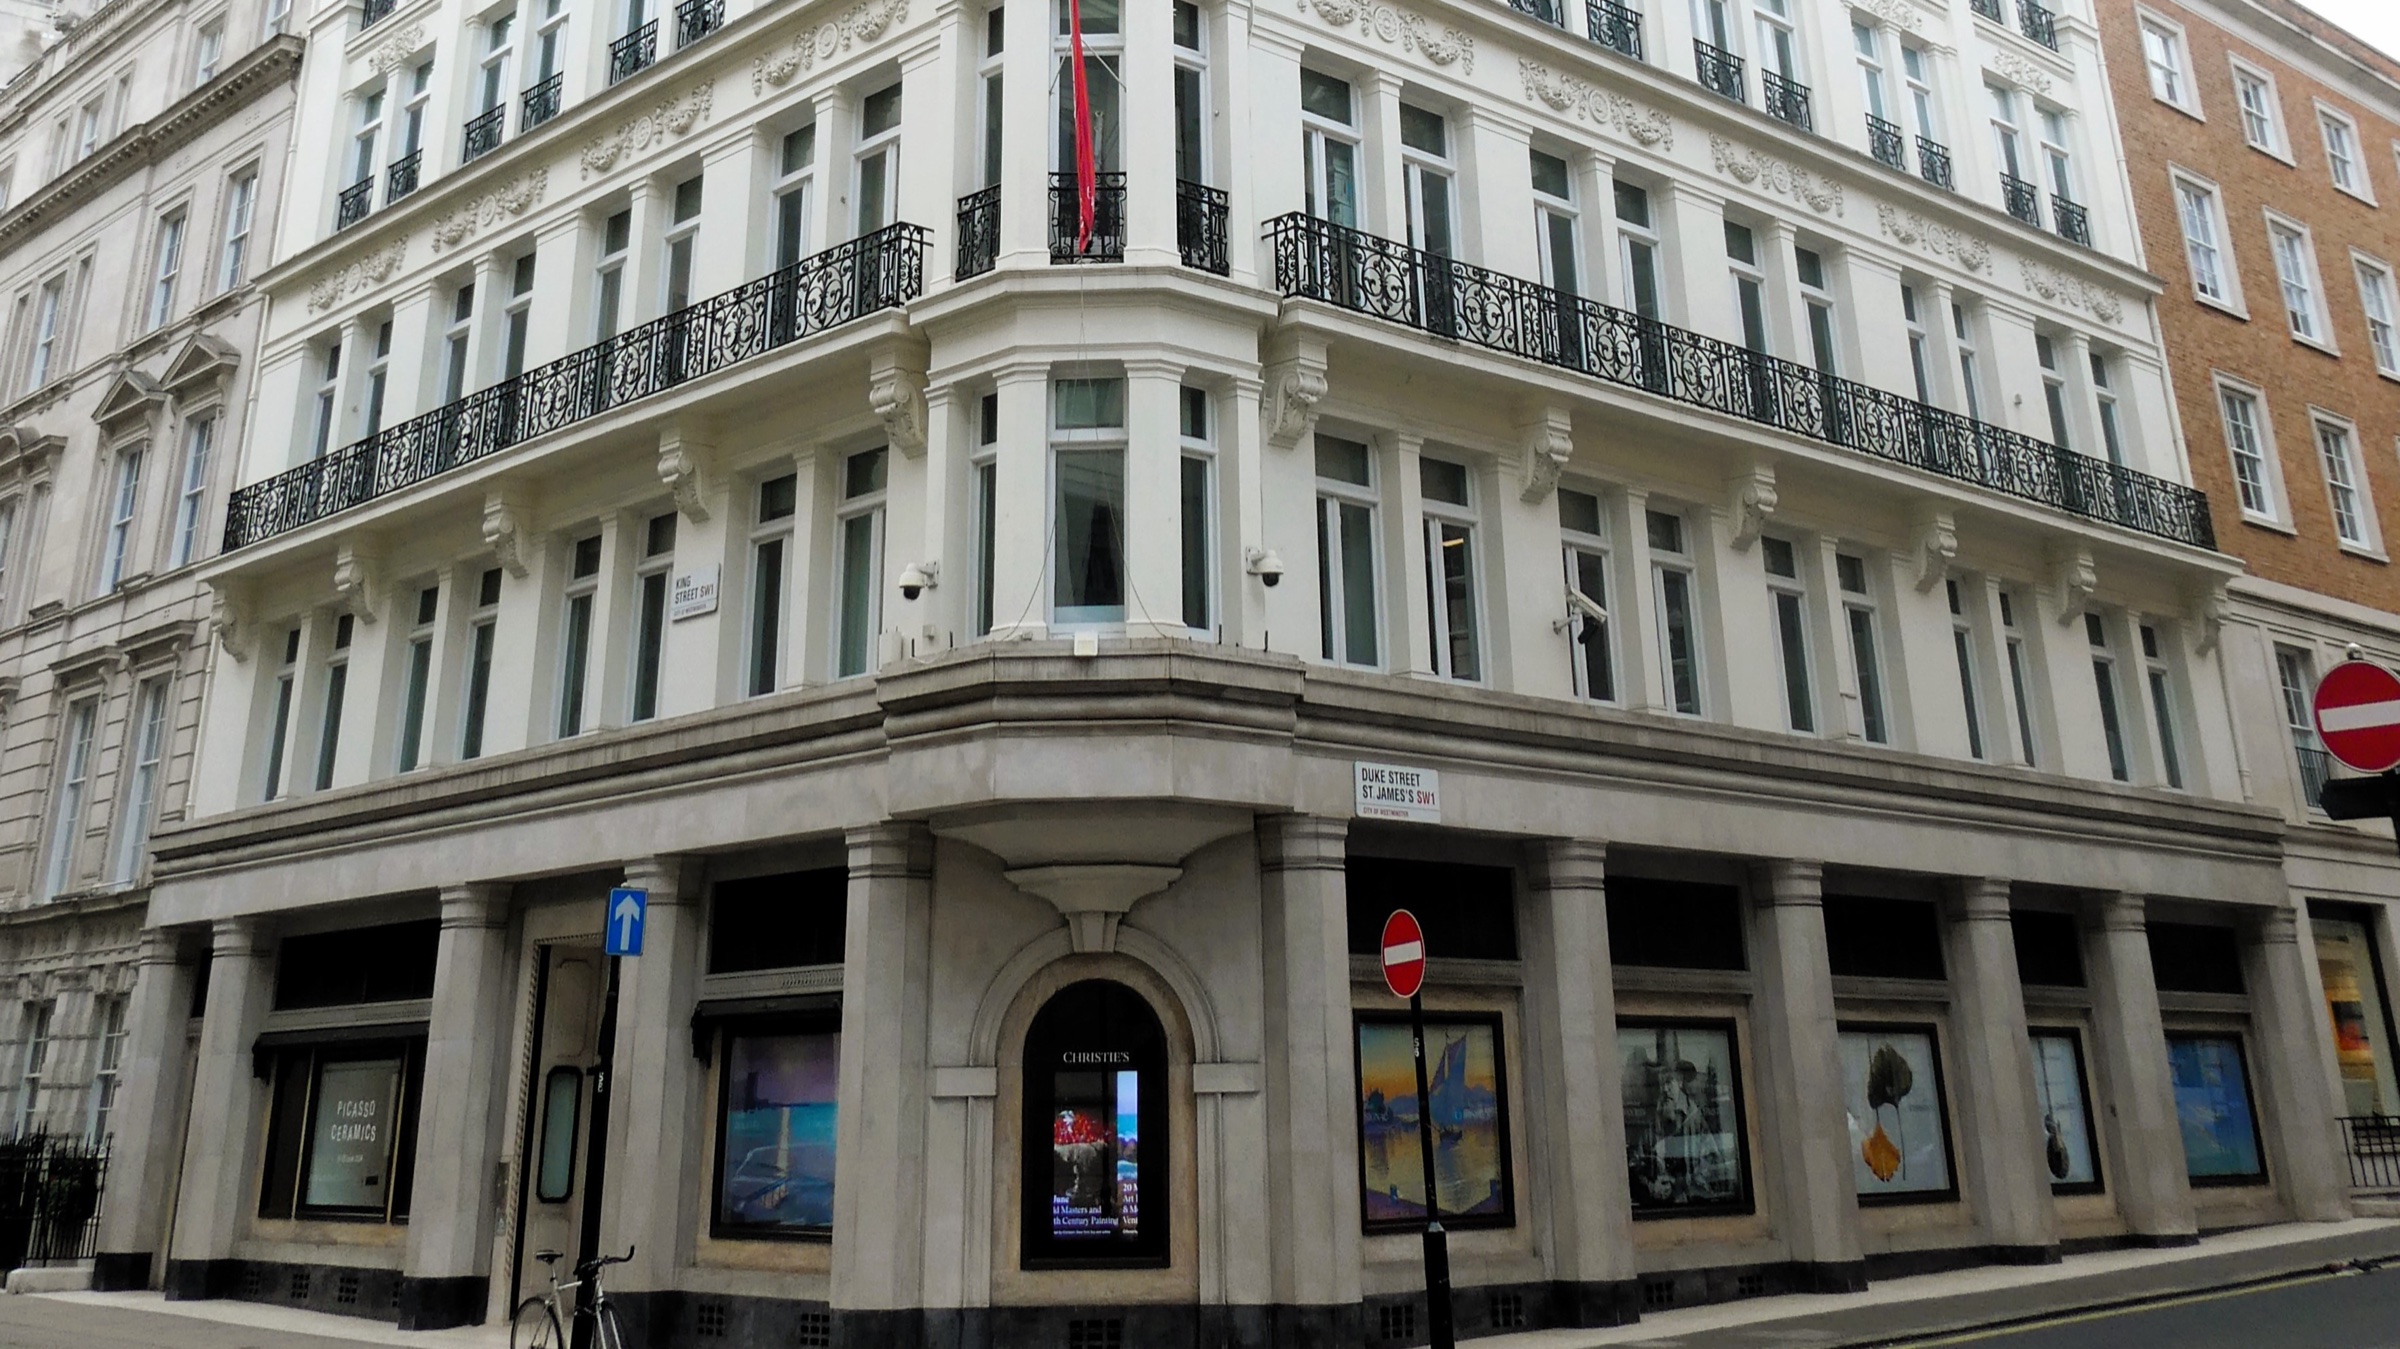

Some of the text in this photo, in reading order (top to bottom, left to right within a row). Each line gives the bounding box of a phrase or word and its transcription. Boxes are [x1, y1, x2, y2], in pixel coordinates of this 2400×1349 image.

[676, 575, 691, 590] KING
[675, 584, 713, 604] STREET SW1
[1362, 768, 1420, 787] DUKE STREET
[1377, 786, 1414, 803] JAMES'S
[1417, 790, 1435, 805] SW1
[1063, 1051, 1129, 1063] CHRISTIE'S
[337, 1100, 376, 1118] PICASSO
[331, 1123, 376, 1142] CERAMICS
[1123, 1183, 1132, 1192] 20
[1123, 1194, 1134, 1203] Art
[1061, 1205, 1088, 1214] Masters
[1089, 1205, 1102, 1214] and
[1062, 1216, 1089, 1226] Century
[1091, 1216, 1119, 1226] Painting
